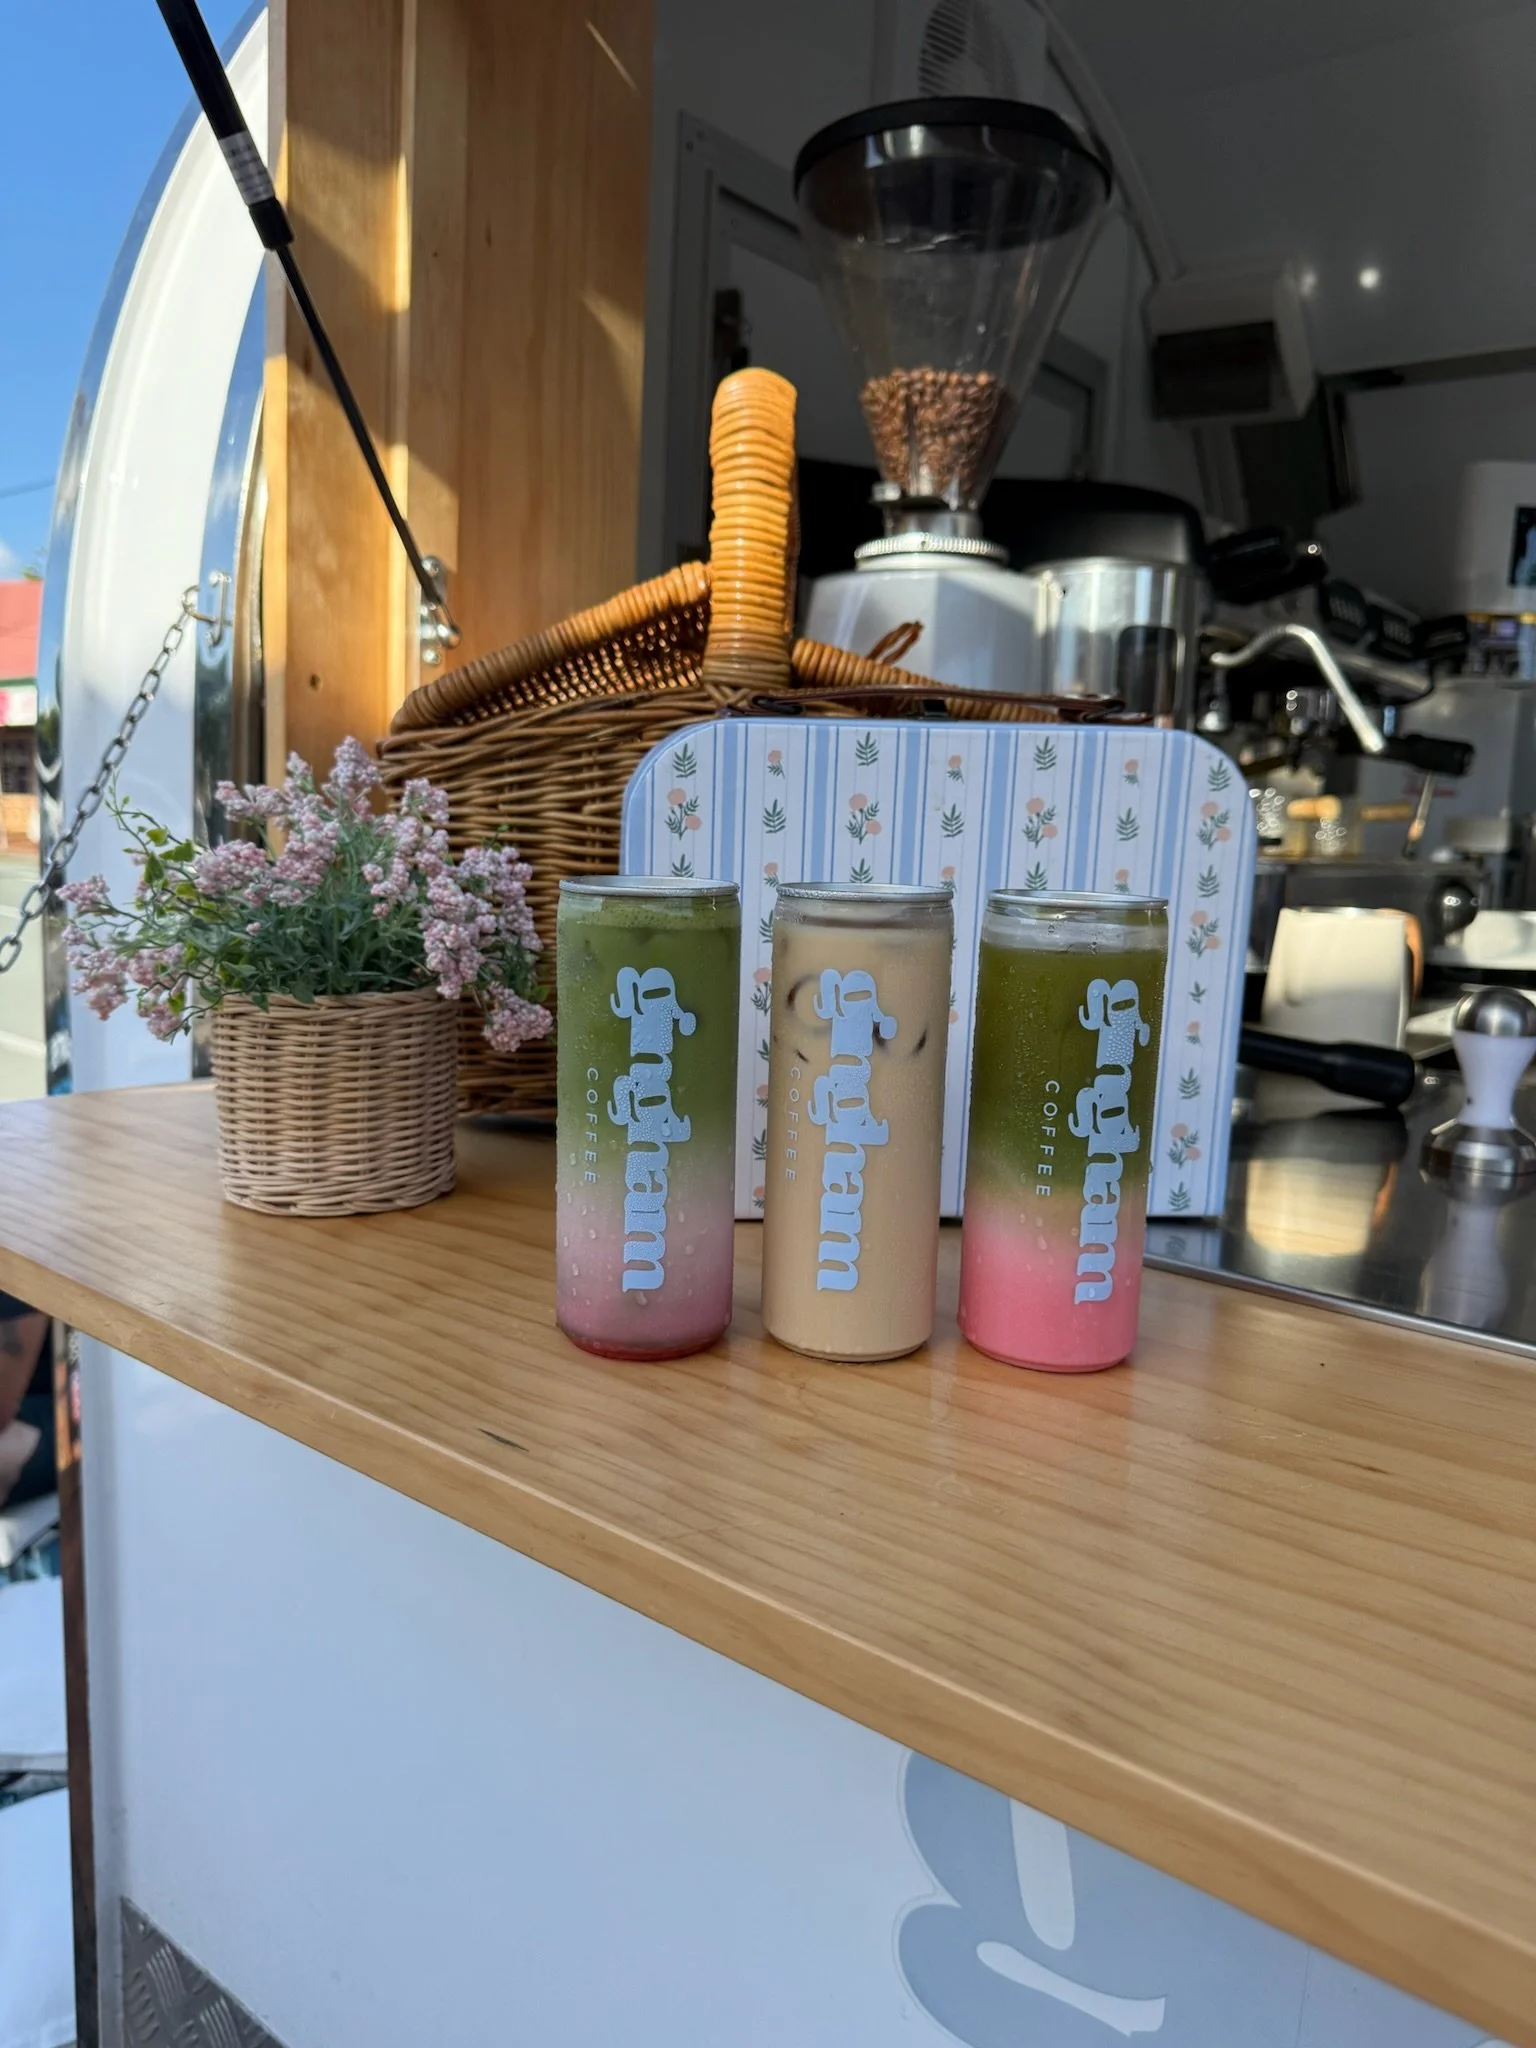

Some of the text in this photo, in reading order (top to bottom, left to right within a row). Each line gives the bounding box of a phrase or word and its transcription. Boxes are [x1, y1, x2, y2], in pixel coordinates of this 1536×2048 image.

[585, 1067, 600, 1183] COFFEE
[607, 967, 697, 1292] gingham
[786, 1066, 801, 1182] COFFEE
[807, 968, 897, 1291] gingham
[1035, 1080, 1061, 1196] COFFEE
[1068, 979, 1151, 1304] gingham
